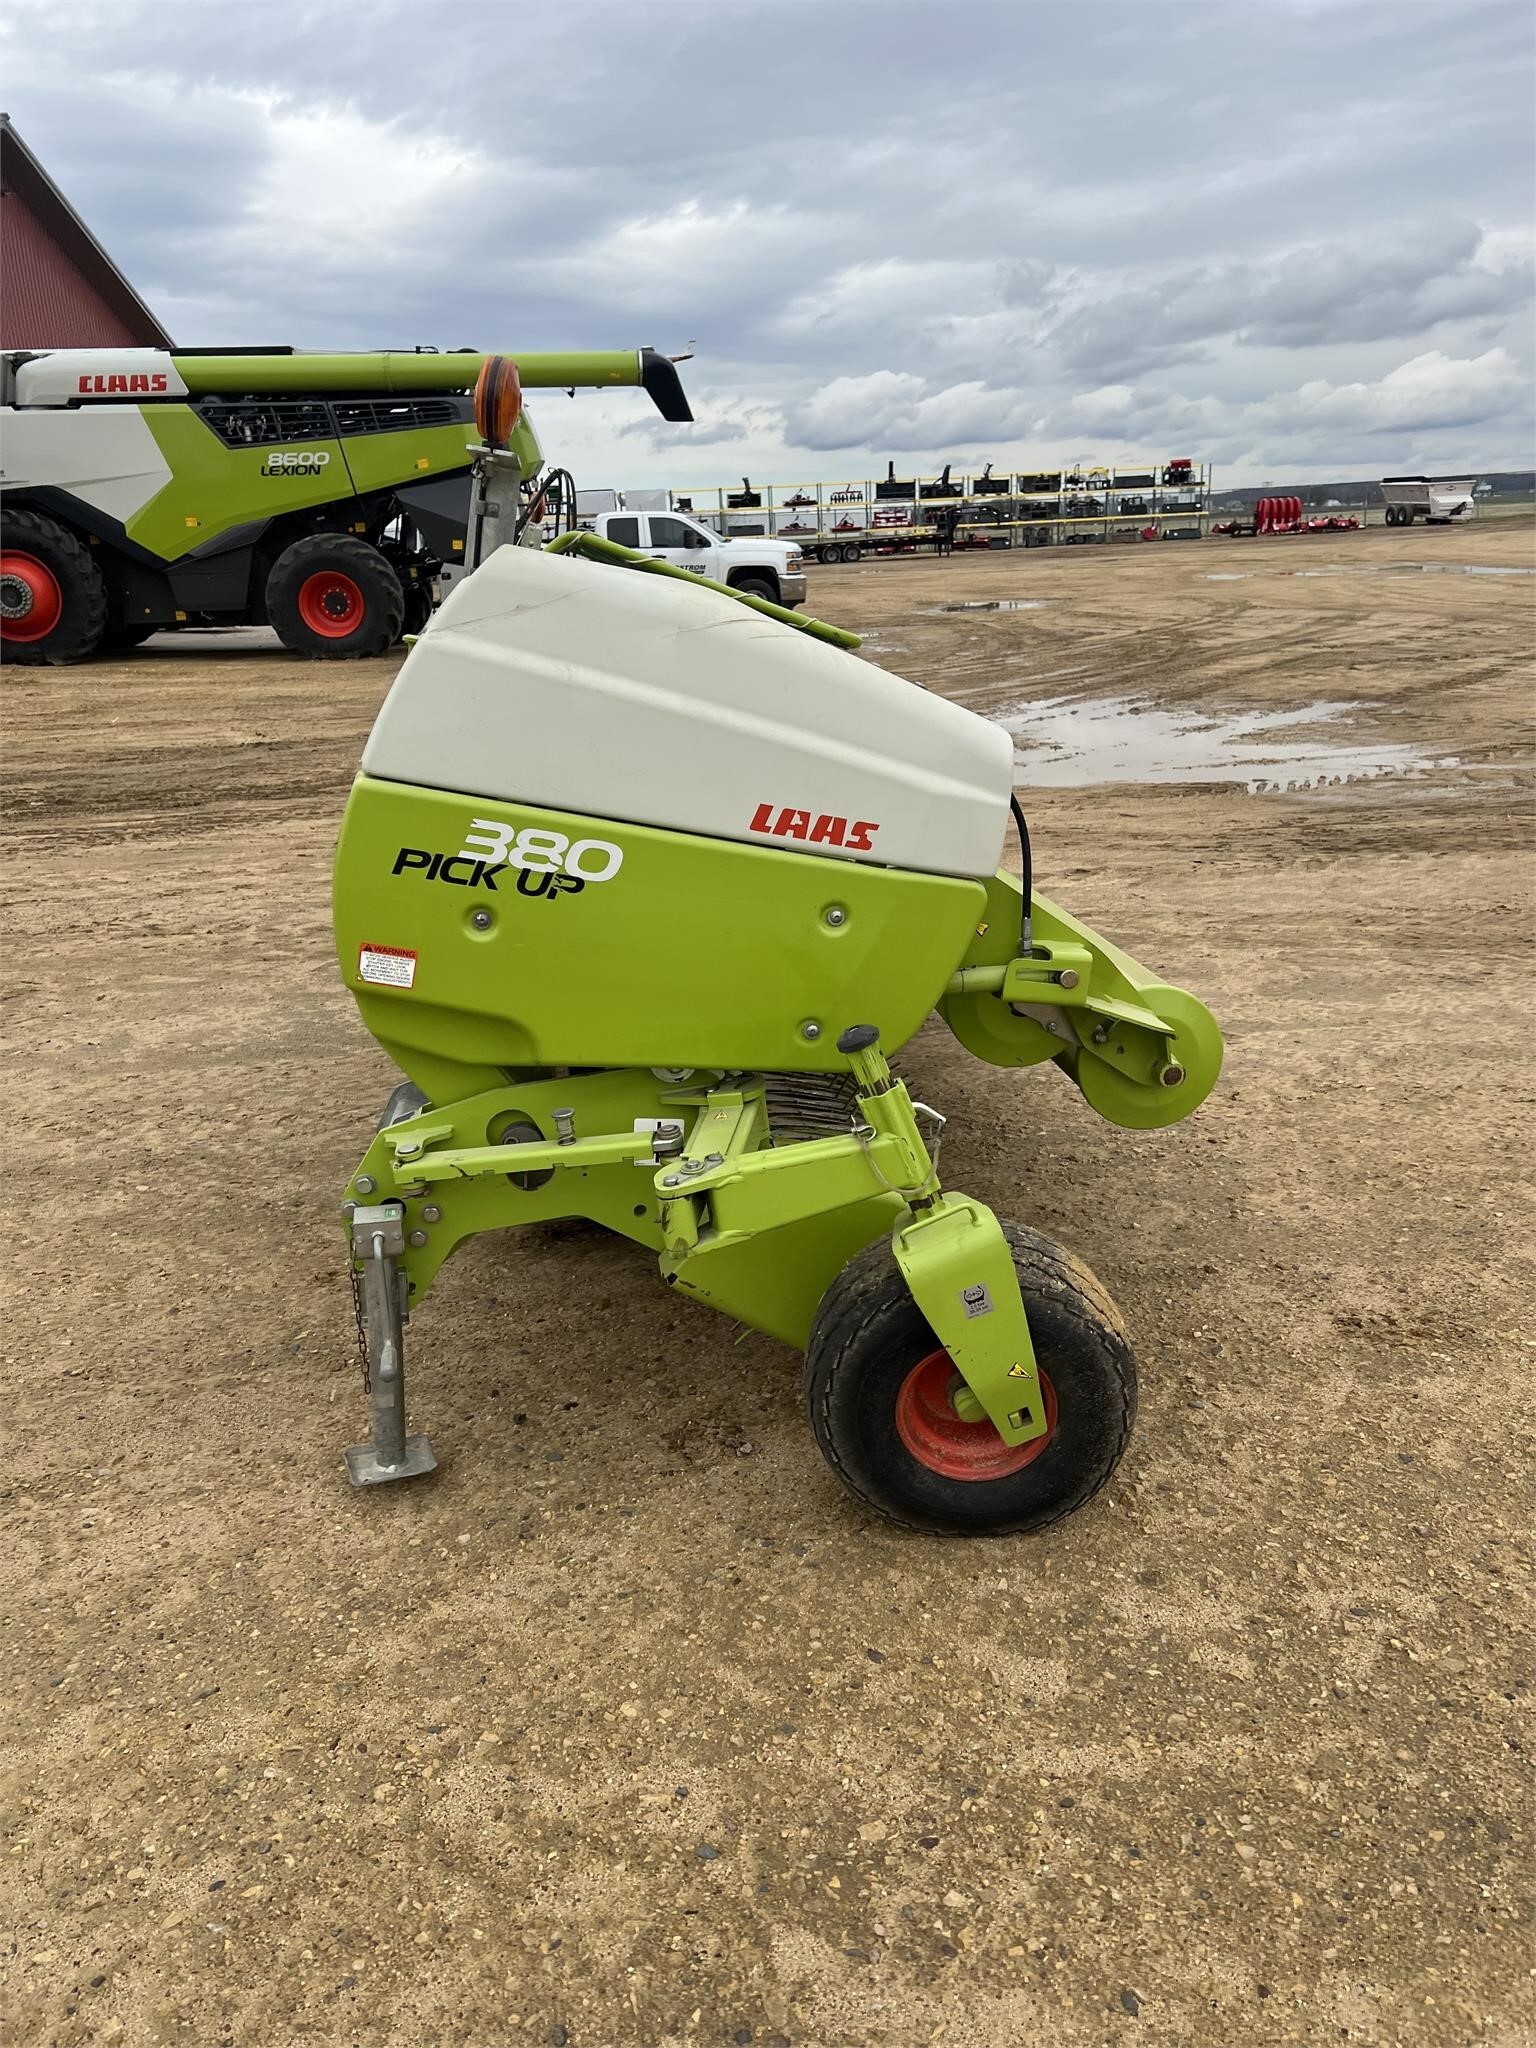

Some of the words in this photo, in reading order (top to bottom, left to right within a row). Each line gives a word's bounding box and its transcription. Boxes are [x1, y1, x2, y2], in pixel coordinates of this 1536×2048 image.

[79, 374, 167, 393] CLAAS
[268, 452, 330, 467] 8600
[261, 465, 321, 476] LEXION
[458, 818, 623, 882] 380
[391, 847, 509, 891] PICK
[516, 867, 585, 900] UP
[374, 945, 416, 958] WARNING
